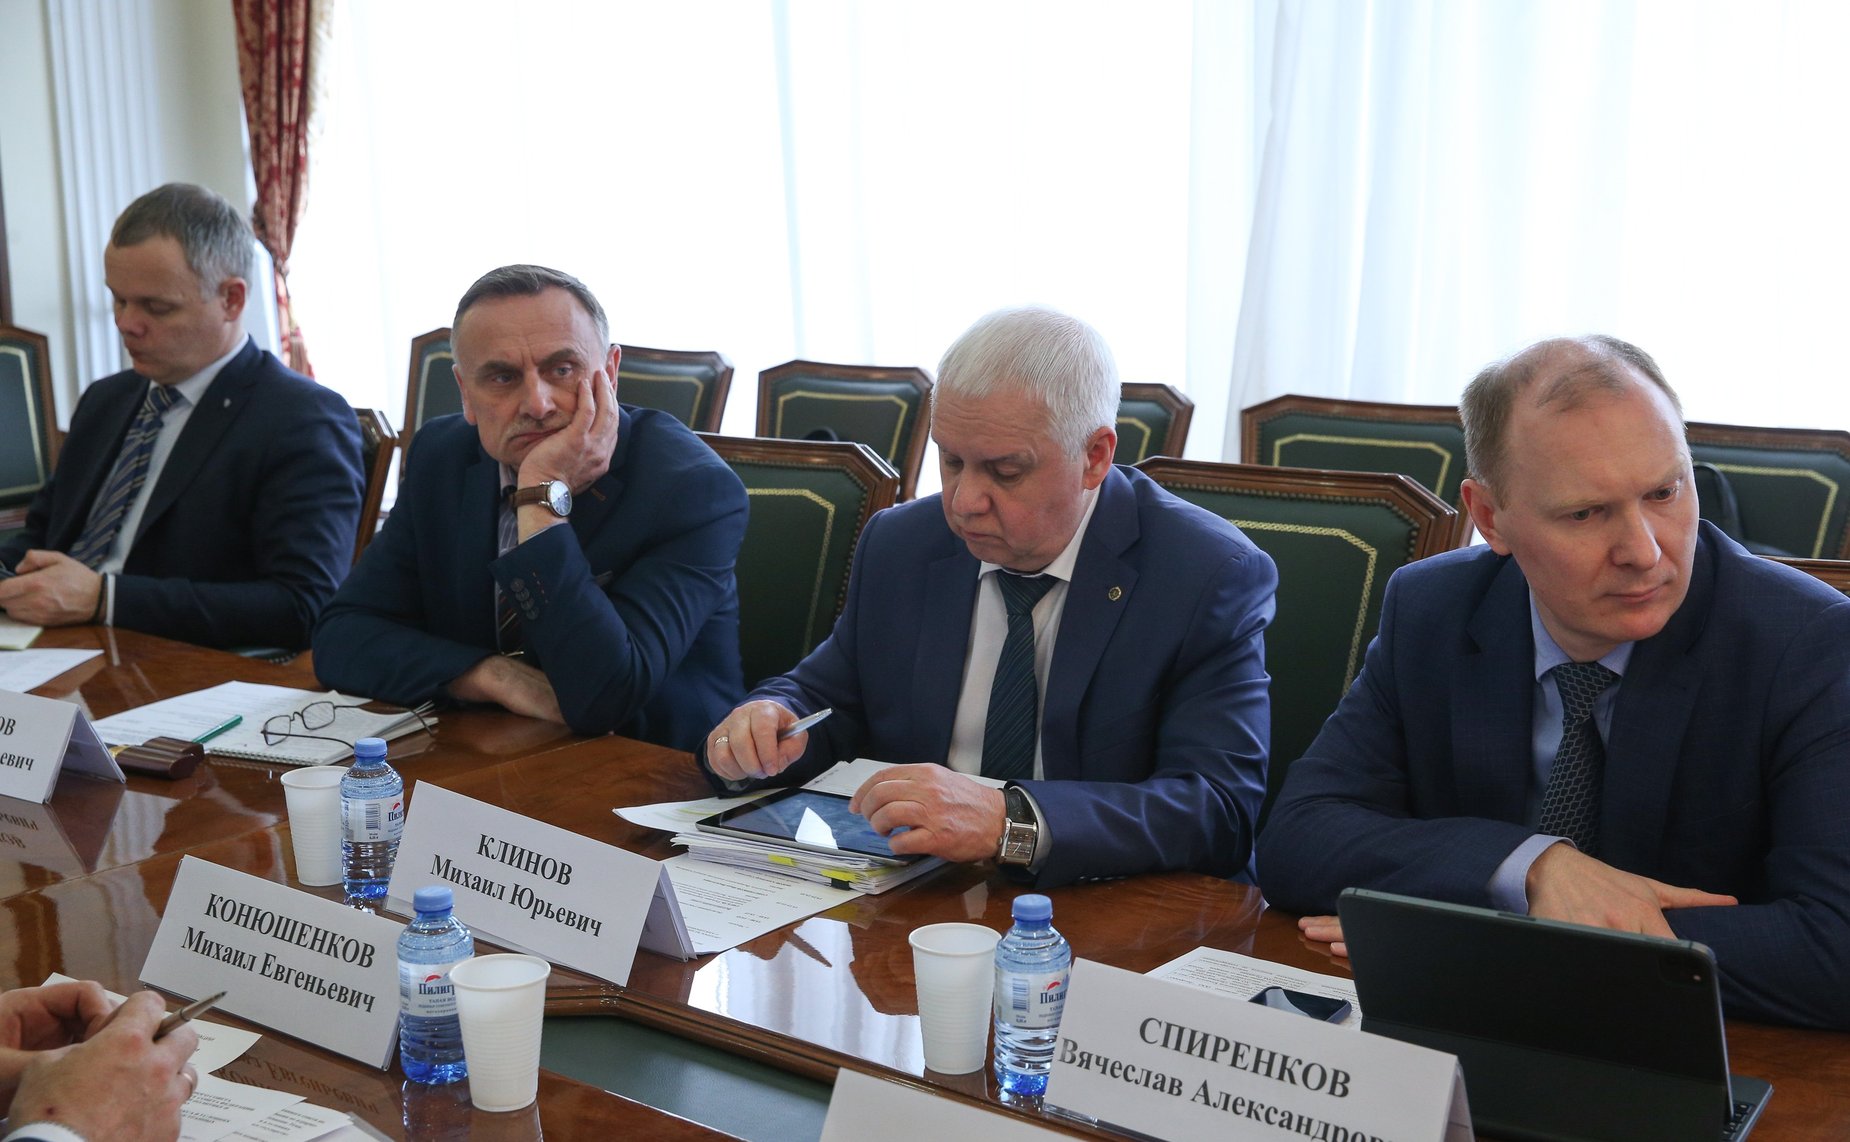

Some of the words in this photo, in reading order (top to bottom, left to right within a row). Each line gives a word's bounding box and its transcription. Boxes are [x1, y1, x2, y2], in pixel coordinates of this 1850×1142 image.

[430, 854, 506, 901] Михаил
[509, 883, 602, 938] Юрьевич
[476, 833, 573, 886] КЛИНОВ
[181, 926, 257, 972] Михаил
[259, 952, 376, 1013] Евгеньевич
[204, 893, 376, 968] КОНЮШЕНКОВ
[1058, 1037, 1183, 1097] Вячеслав
[1139, 1017, 1351, 1098] СПИРЕНКОВ
